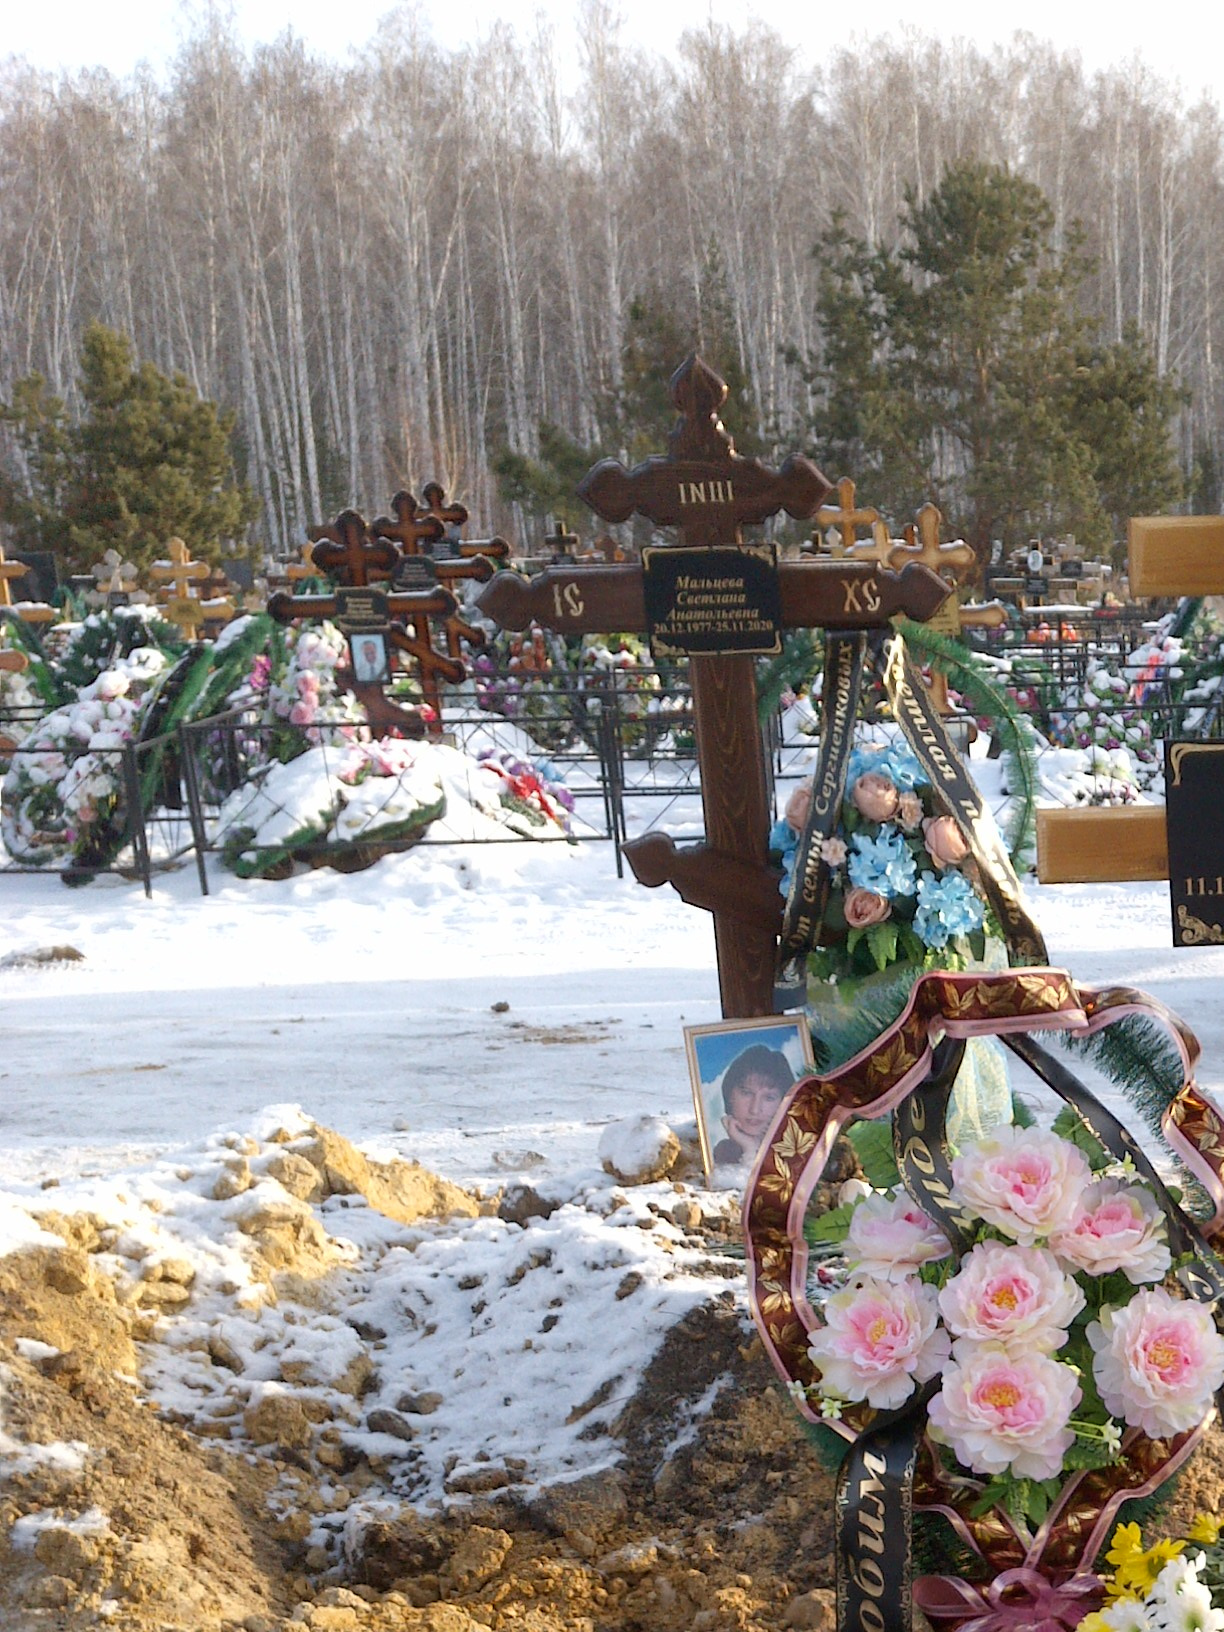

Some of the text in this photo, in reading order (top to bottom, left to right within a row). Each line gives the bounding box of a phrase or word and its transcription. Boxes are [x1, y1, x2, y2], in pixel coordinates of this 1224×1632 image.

[675, 576, 745, 591] Мальцева
[676, 590, 747, 606] Светлана
[666, 607, 760, 622] Анатольевна
